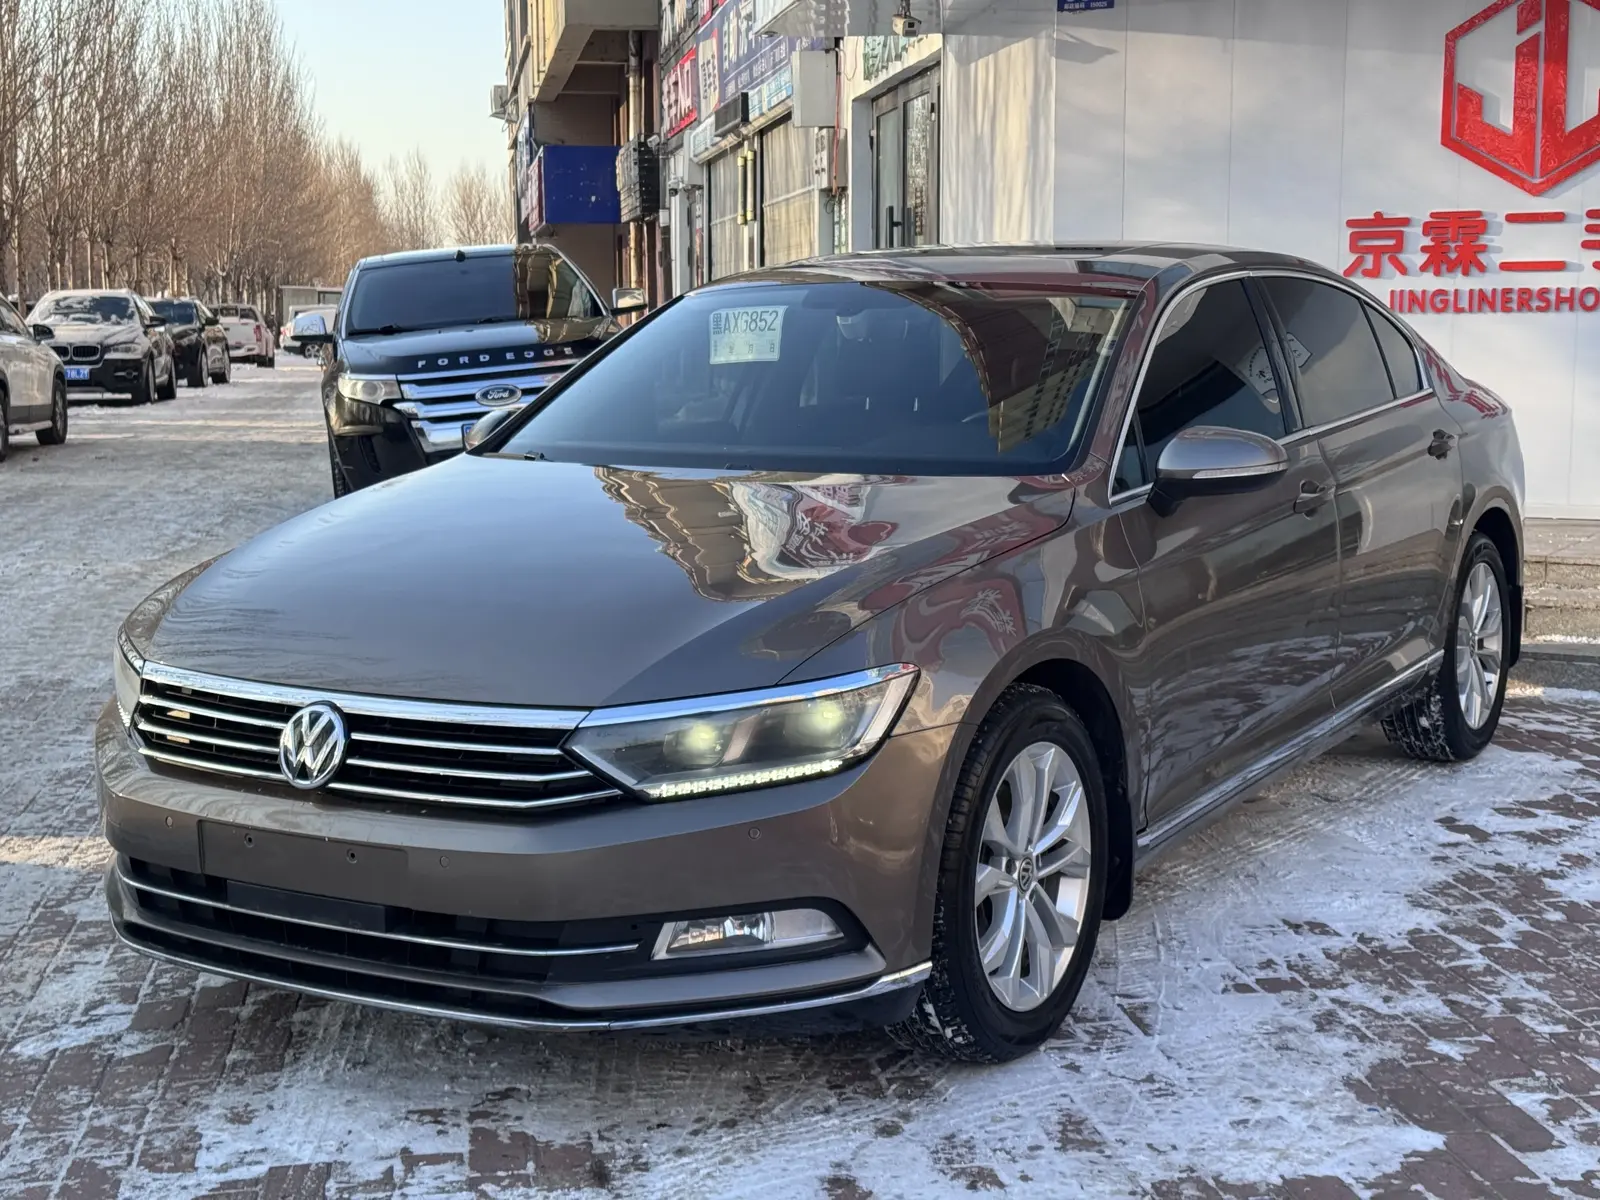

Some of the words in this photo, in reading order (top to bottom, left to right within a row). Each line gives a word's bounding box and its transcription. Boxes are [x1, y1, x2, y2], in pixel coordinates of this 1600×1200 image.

[1342, 209, 1600, 278] 京霖二
[417, 354, 490, 369] FORD
[505, 346, 574, 360] EDGE
[487, 389, 510, 400] Ford
